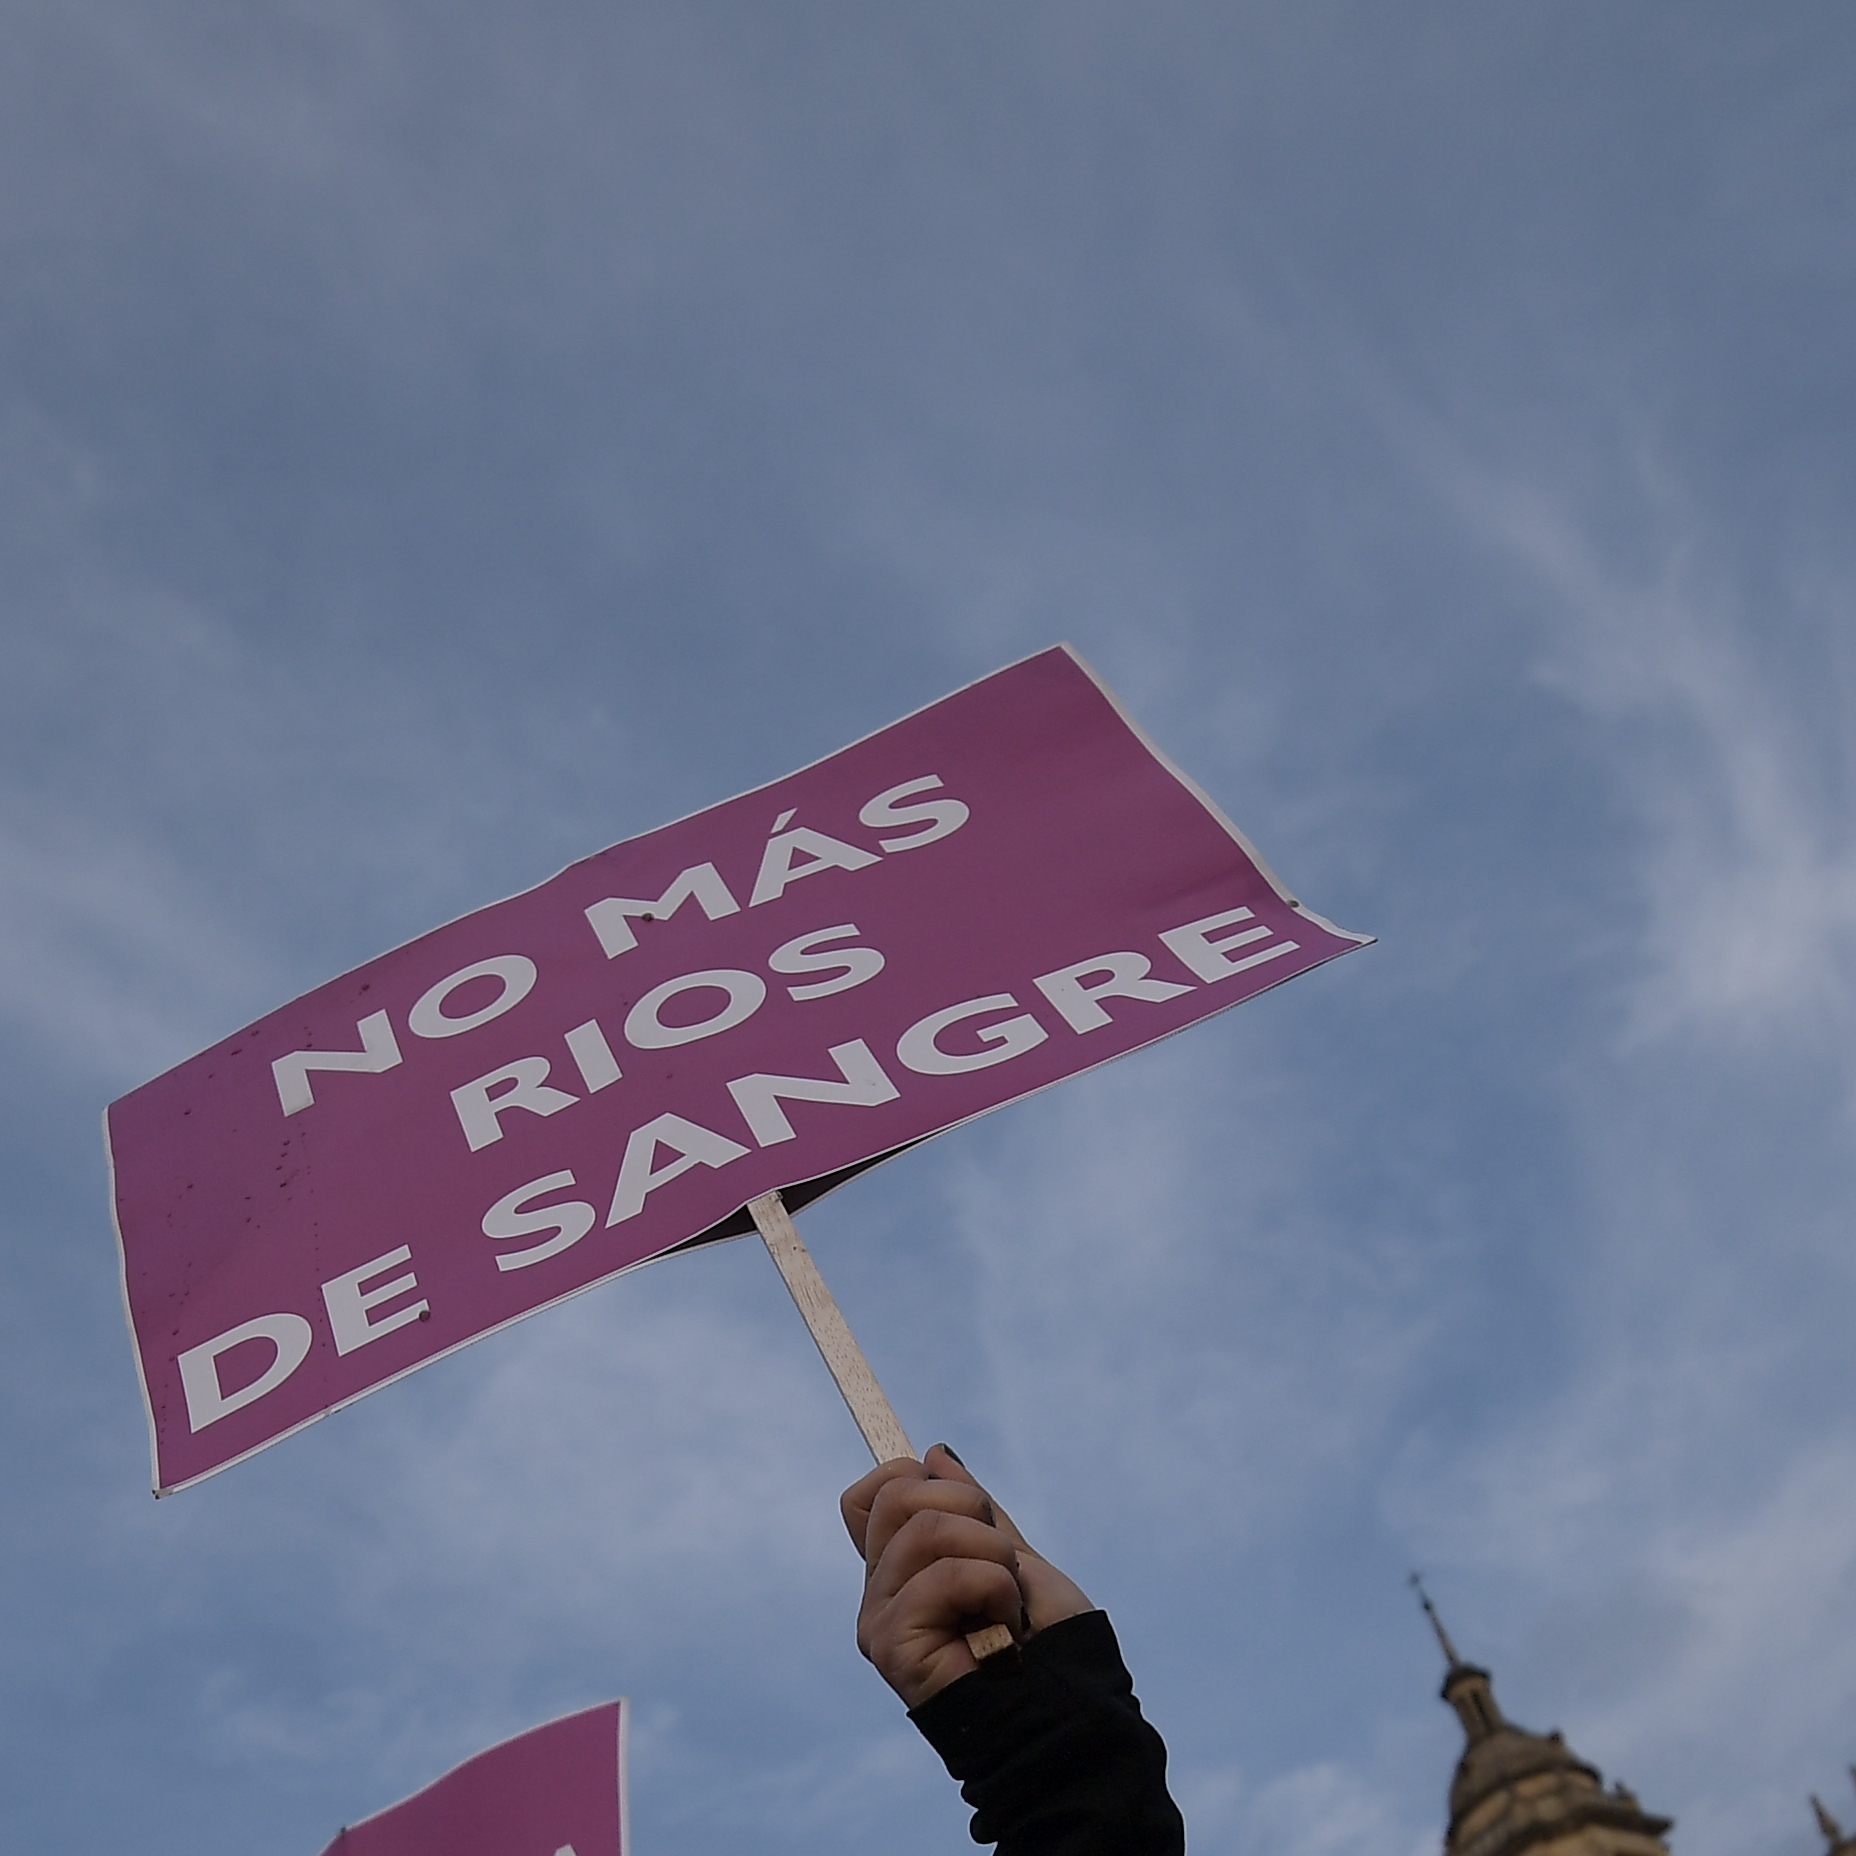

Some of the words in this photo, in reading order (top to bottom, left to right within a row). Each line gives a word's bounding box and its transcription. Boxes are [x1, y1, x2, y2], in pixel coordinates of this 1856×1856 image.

[272, 955, 537, 1116] NO
[585, 775, 969, 959] MÁS
[450, 924, 885, 1151] RIOS
[178, 1245, 429, 1433] DE
[482, 907, 1298, 1271] SANGRE
